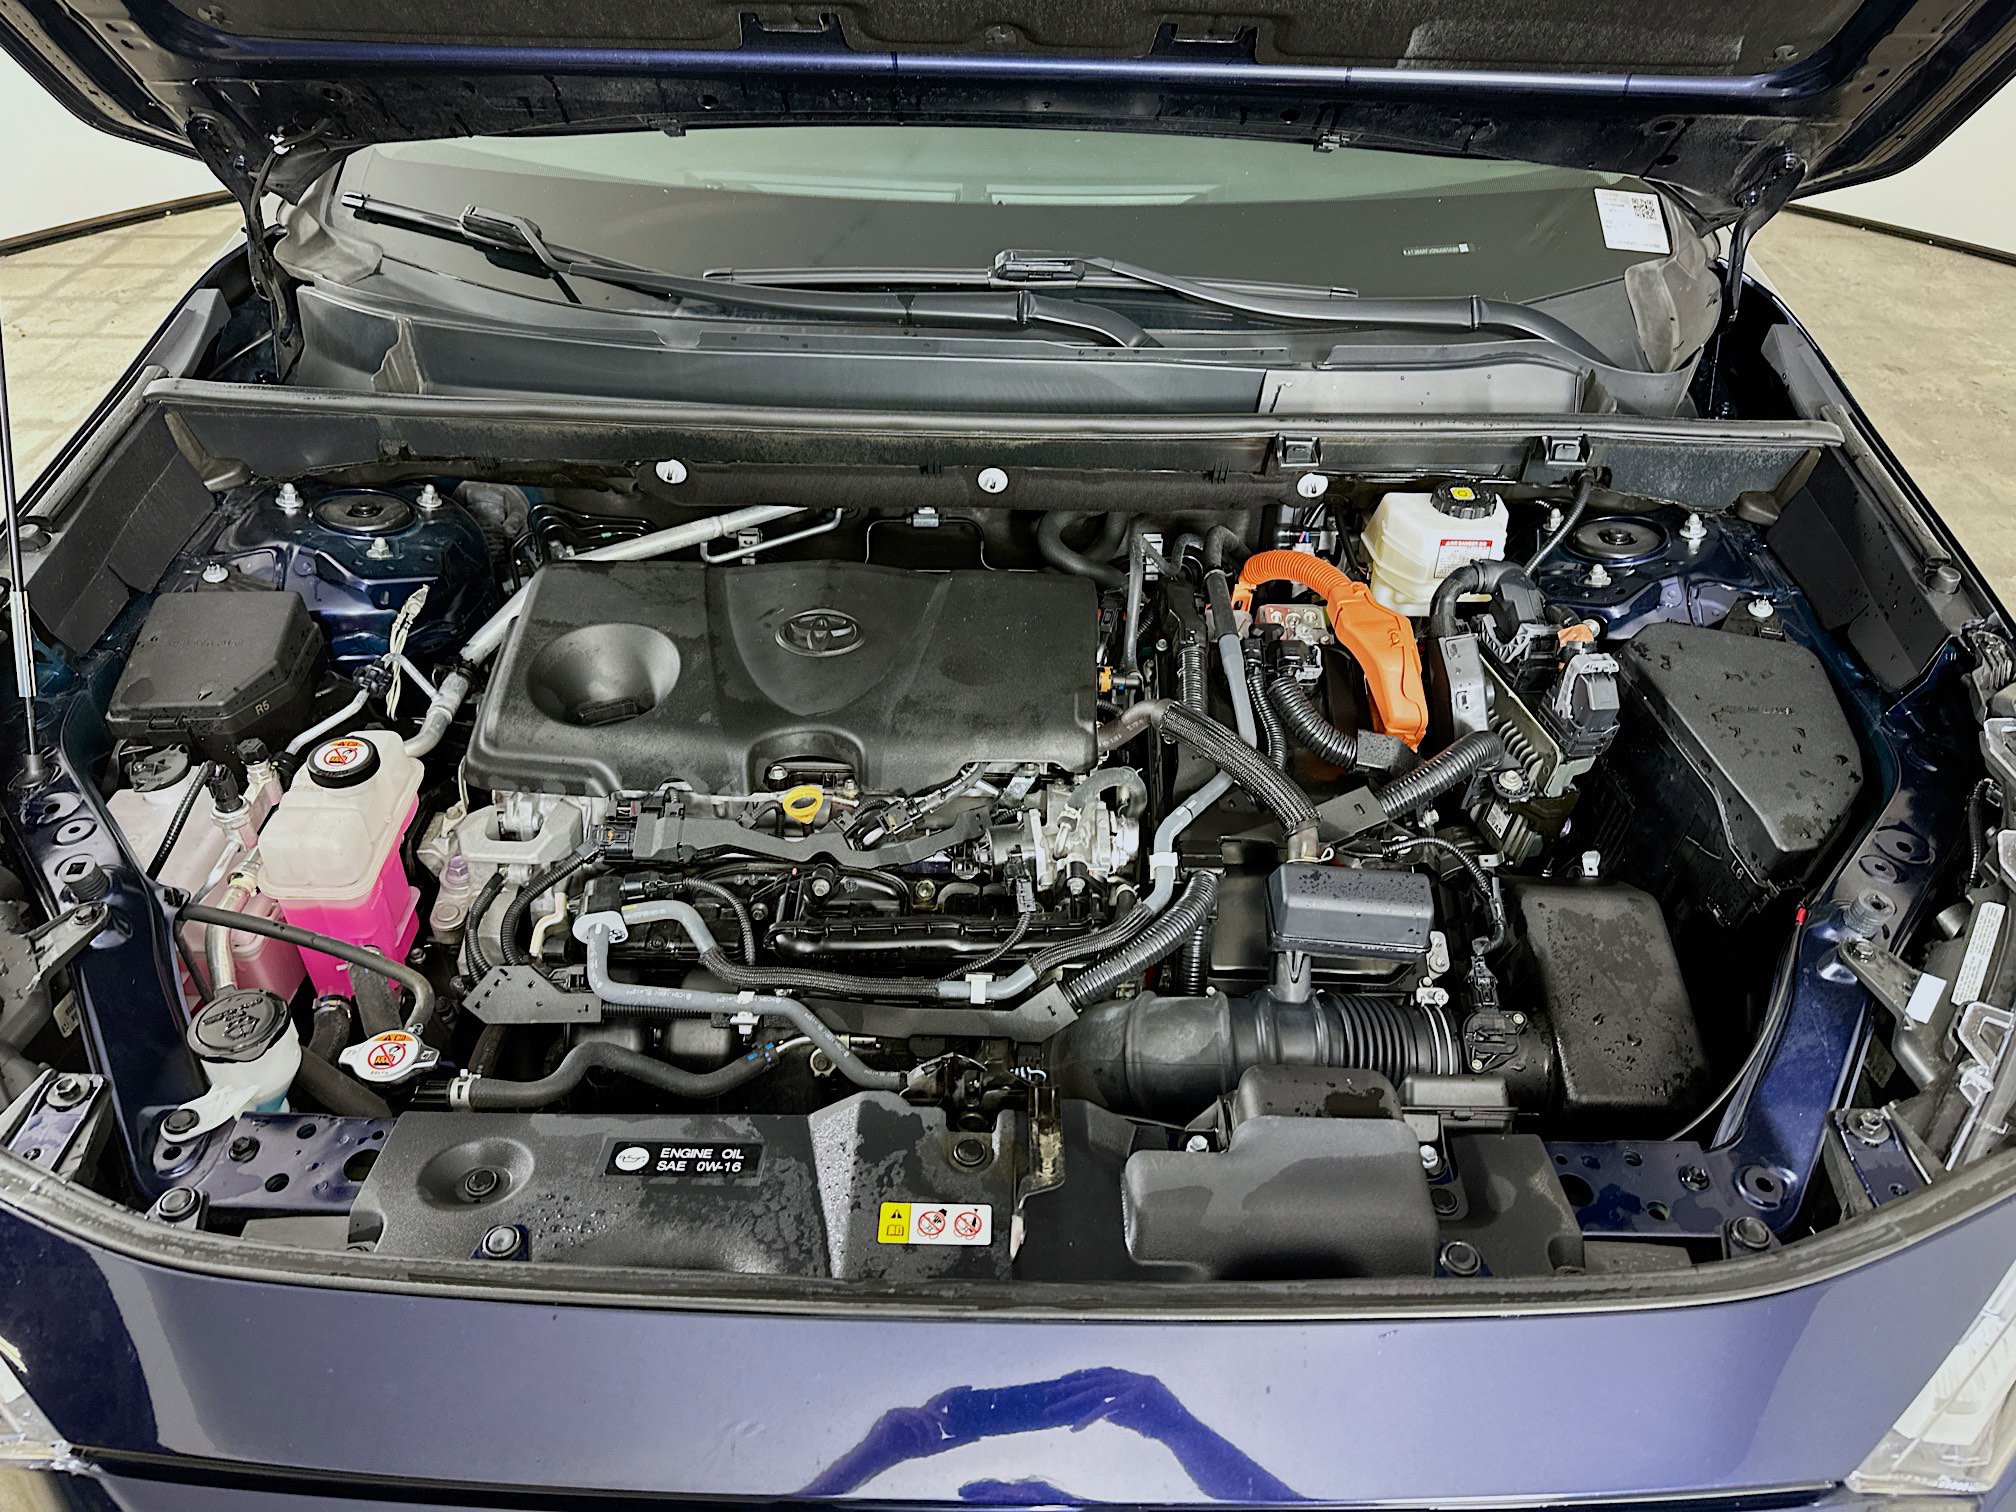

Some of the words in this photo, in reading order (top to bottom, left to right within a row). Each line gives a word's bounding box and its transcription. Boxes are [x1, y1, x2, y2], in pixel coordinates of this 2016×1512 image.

[255, 700, 270, 715] R5
[1731, 860, 1744, 880] L6
[660, 1148, 714, 1159] ENGINE
[721, 1148, 745, 1160] OIL
[656, 1160, 688, 1172] SAE
[696, 1161, 742, 1173] 0W-16
